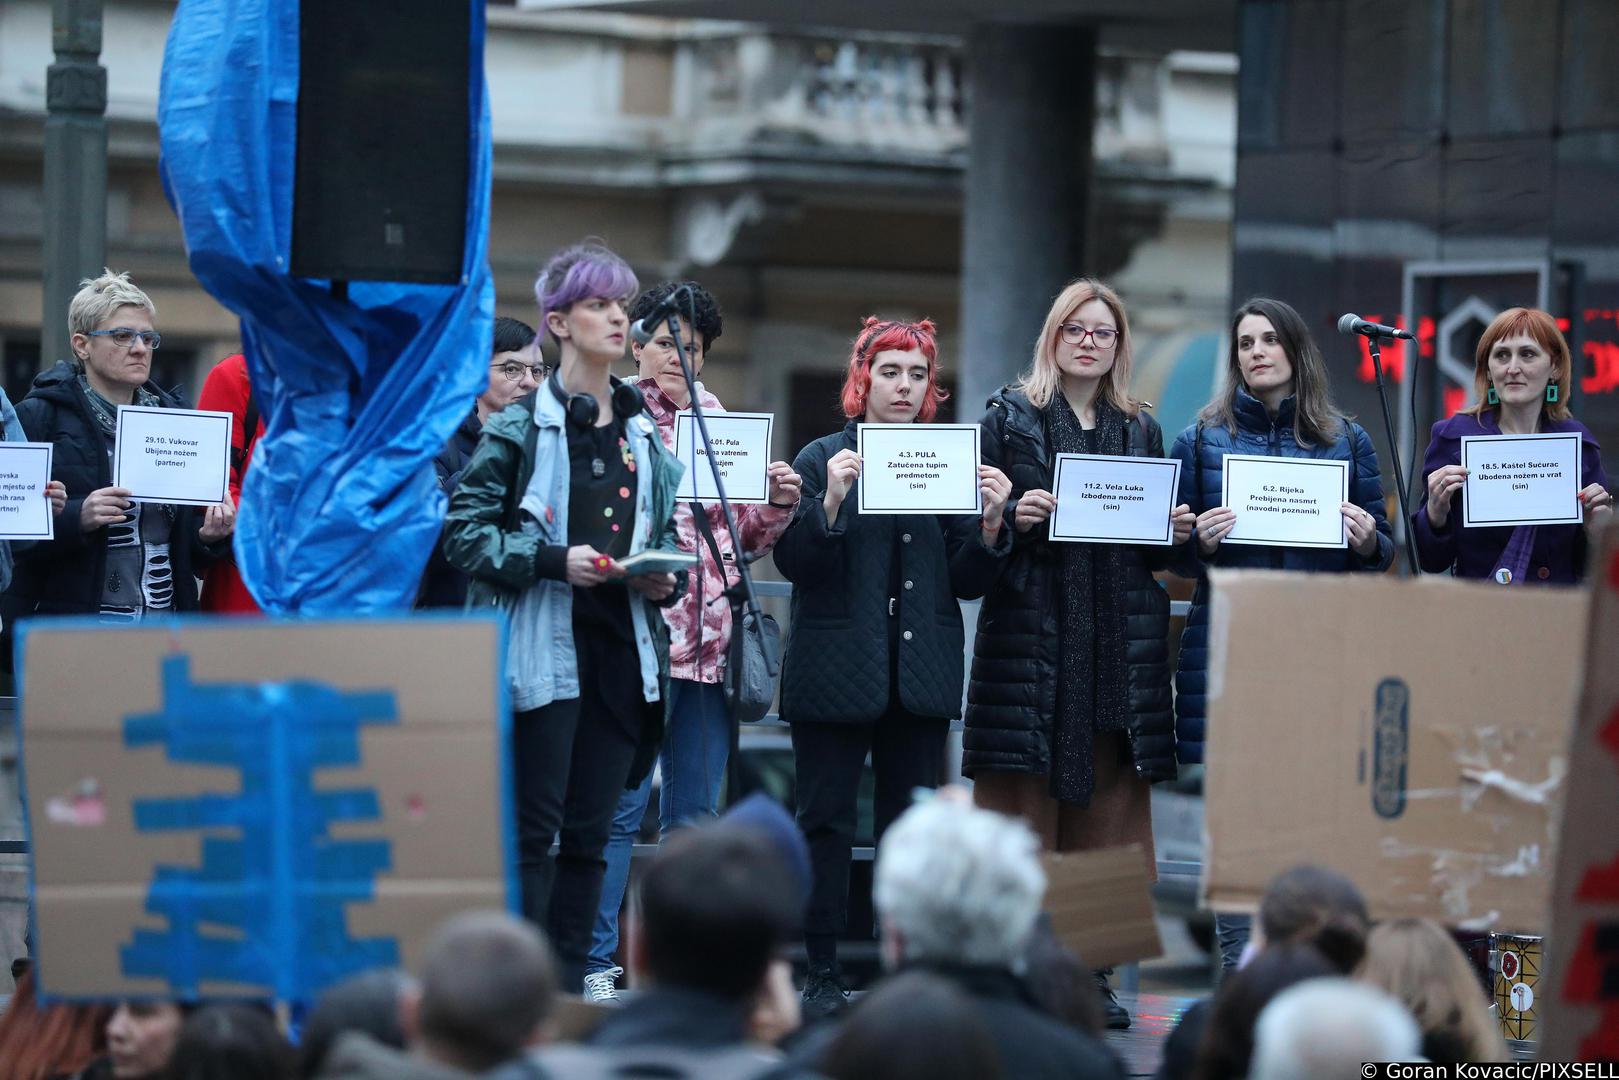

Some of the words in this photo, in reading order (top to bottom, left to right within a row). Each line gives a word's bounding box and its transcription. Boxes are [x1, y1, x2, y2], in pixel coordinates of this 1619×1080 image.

[145, 436, 167, 444] 29.10.
[169, 437, 198, 446] Vukovar
[145, 447, 172, 456] Ubijena
[696, 448, 720, 456] Ubijna
[155, 459, 186, 468] (partner)
[926, 461, 948, 470] tupim
[896, 472, 940, 480] predmetom
[1478, 473, 1512, 481] Ubodena
[2, 483, 26, 491] mjestu
[909, 482, 927, 490] (sin)
[1084, 482, 1103, 490] 11.2.
[1105, 483, 1123, 491] Vela
[1124, 484, 1144, 492] Luka
[1279, 486, 1305, 495] Rijeka
[1512, 482, 1529, 490] (sin)
[1081, 492, 1117, 500] Izbodena
[1250, 494, 1287, 503] Prebijena
[1102, 503, 1121, 512] (sin)
[1246, 504, 1280, 513] (navodni
[1281, 507, 1320, 516] poznanik)
